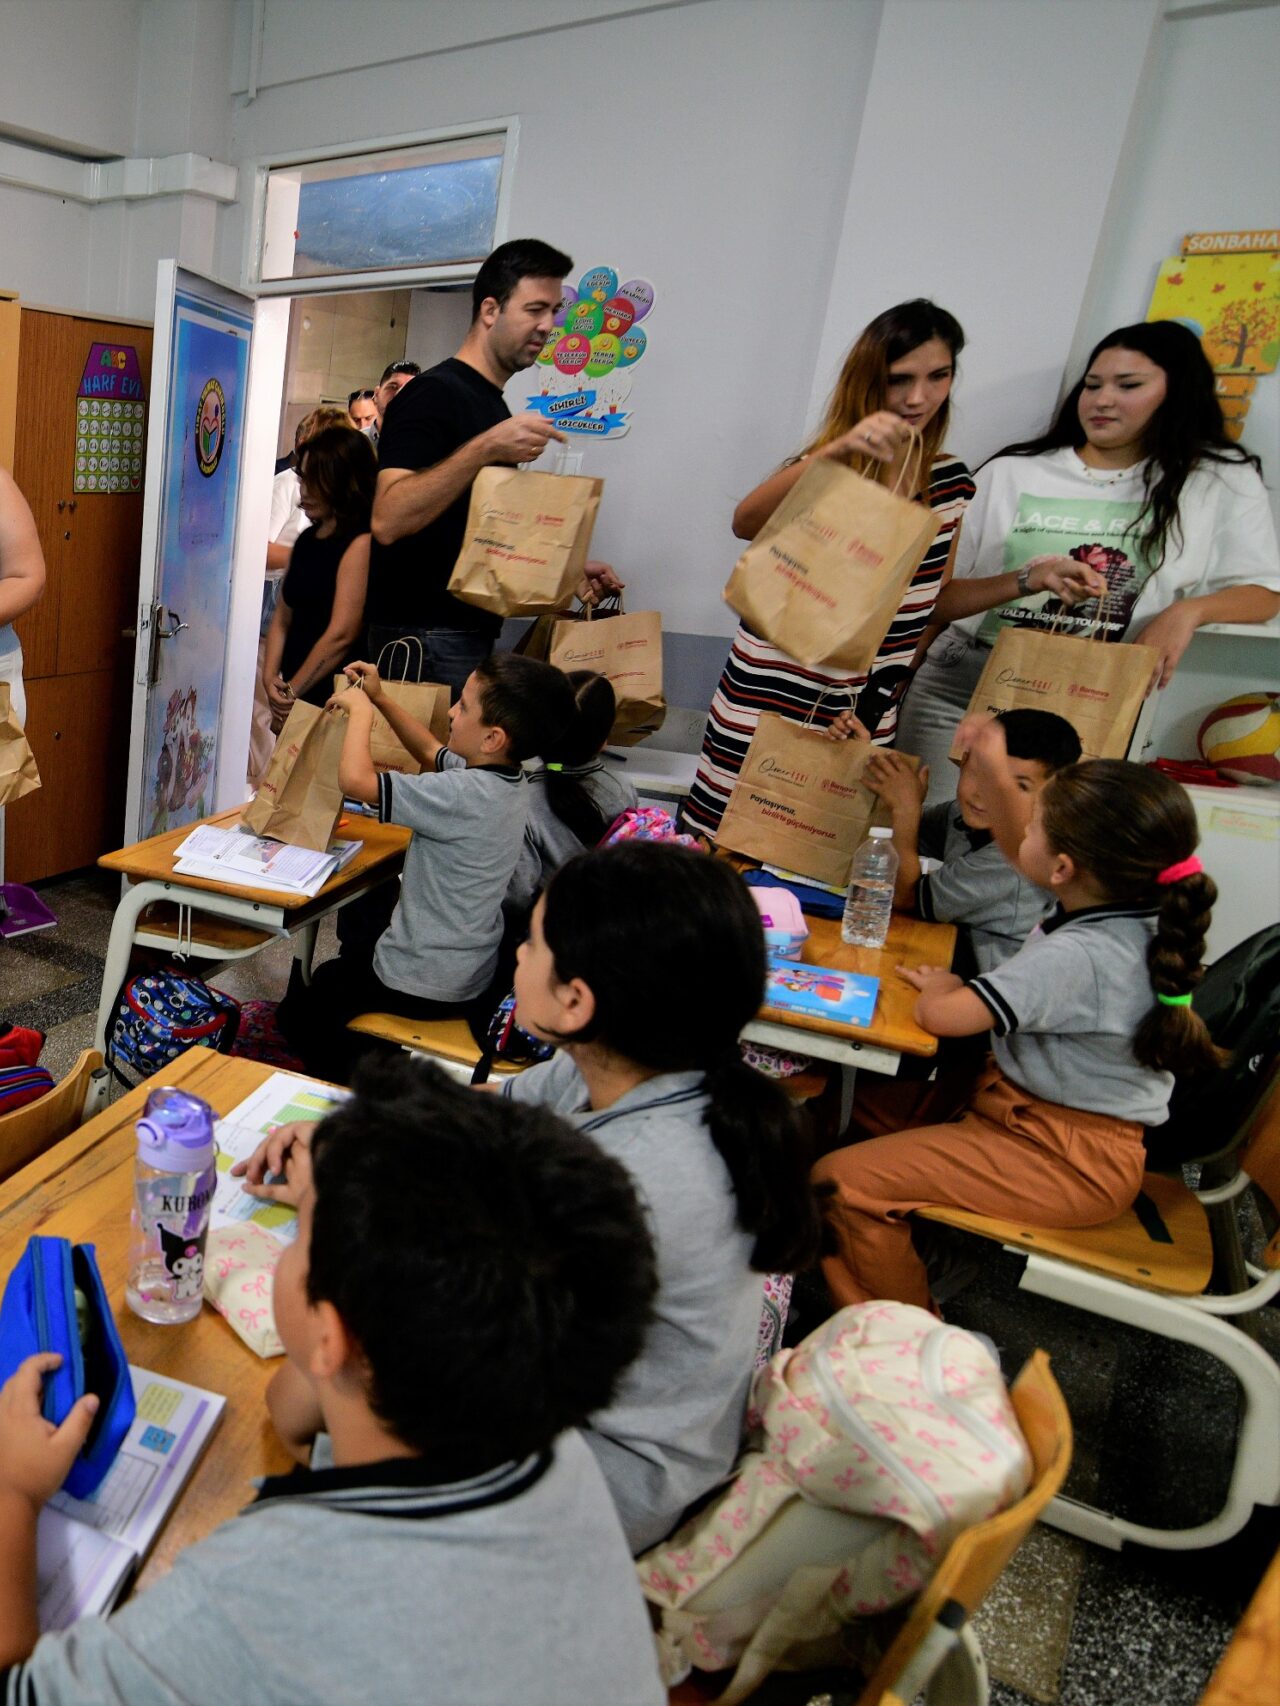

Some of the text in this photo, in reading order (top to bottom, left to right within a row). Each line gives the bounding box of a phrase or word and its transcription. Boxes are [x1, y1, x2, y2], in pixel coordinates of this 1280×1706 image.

[1188, 232, 1277, 250] SONBAHA
[83, 373, 117, 396] HARF
[1012, 510, 1080, 531] LACE
[749, 793, 797, 816] Paylaşıyoruz,
[161, 1189, 212, 1213] KURO
